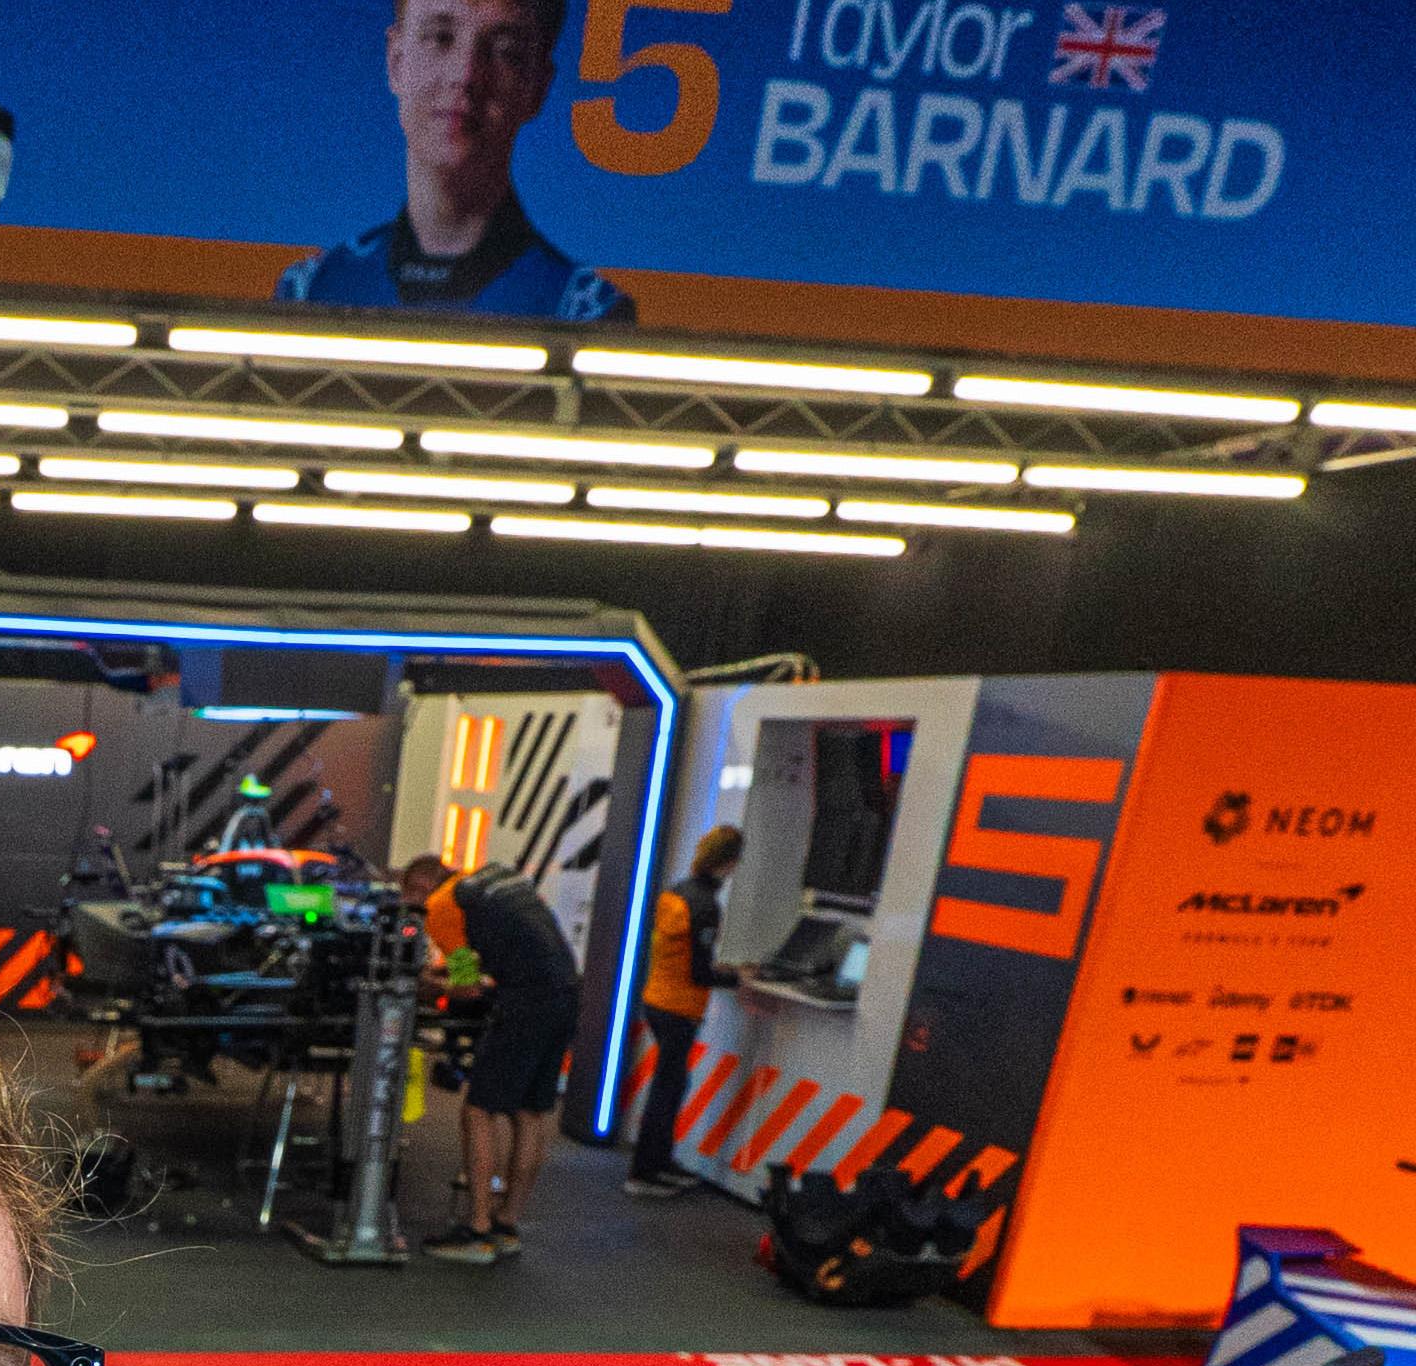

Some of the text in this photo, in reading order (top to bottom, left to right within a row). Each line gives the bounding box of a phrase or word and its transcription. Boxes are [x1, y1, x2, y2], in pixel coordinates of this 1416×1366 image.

[572, 0, 733, 176] 5
[752, 78, 1286, 220] BARNARD
[1264, 806, 1377, 838] NEOM
